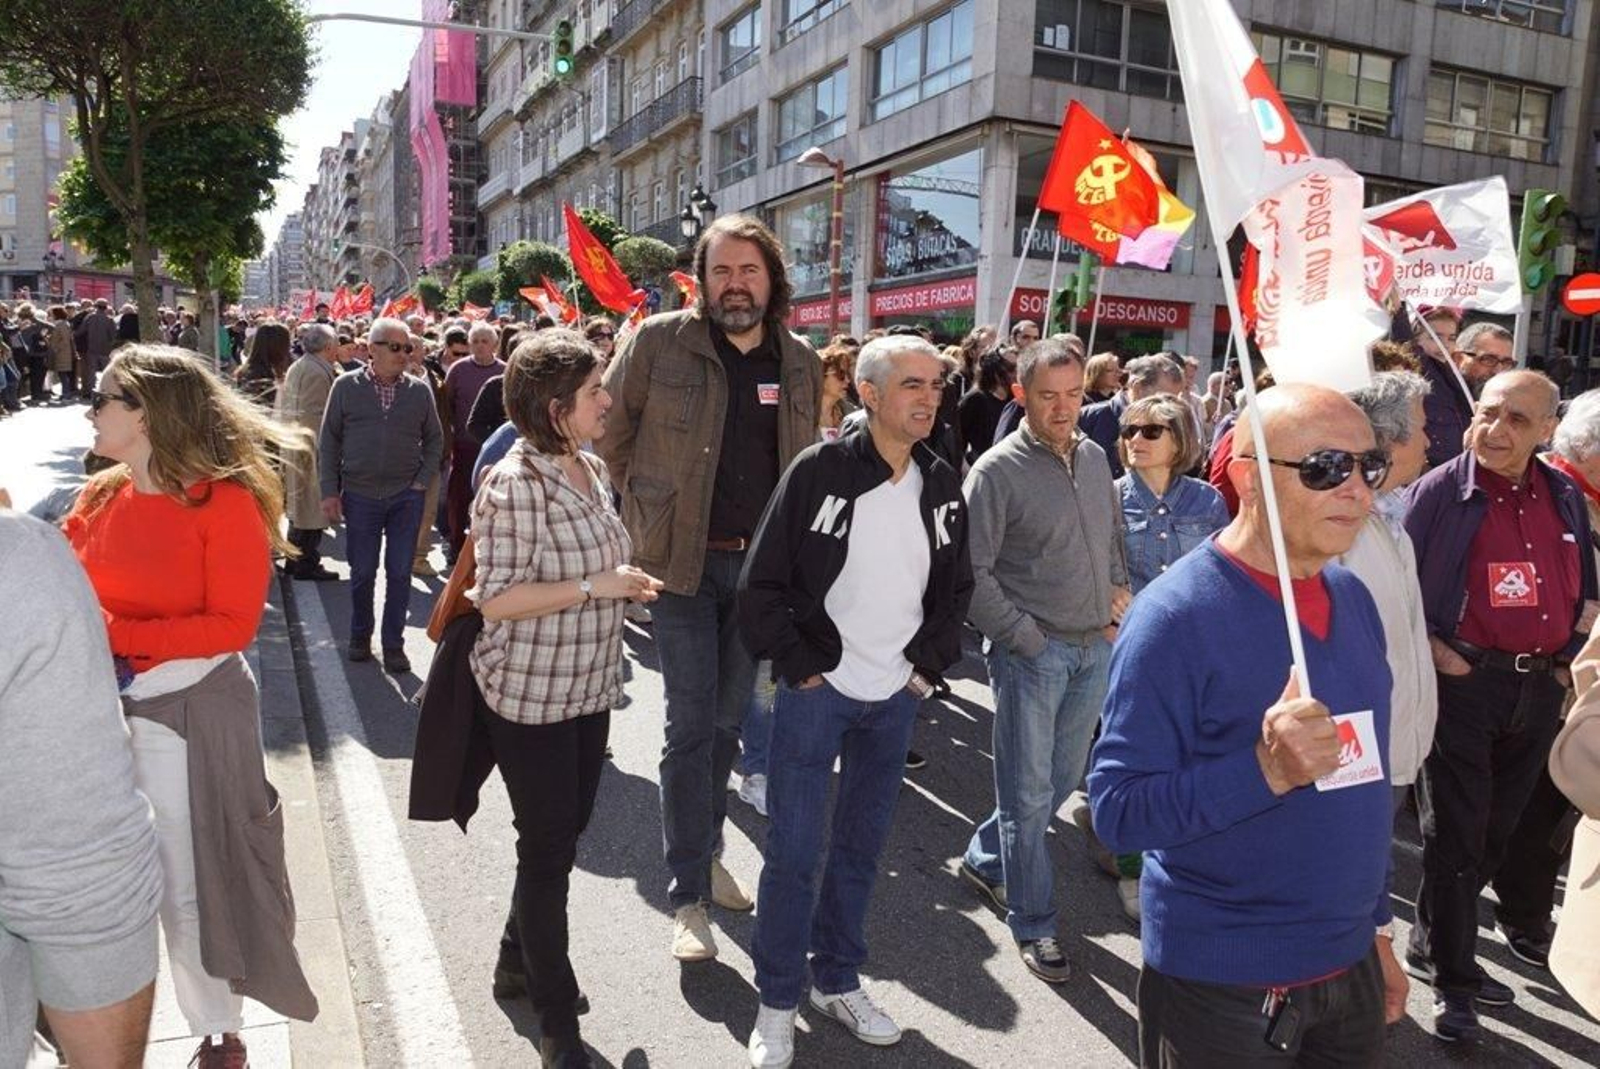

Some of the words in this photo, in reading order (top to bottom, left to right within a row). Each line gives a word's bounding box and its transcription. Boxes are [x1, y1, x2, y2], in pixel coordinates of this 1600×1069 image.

[1396, 258, 1435, 279] erda
[1441, 260, 1495, 281] unida
[876, 292, 914, 312] PRECIOS
[916, 289, 929, 307] DE
[930, 284, 974, 306] FABRICA
[1098, 302, 1178, 323] DESCANSO
